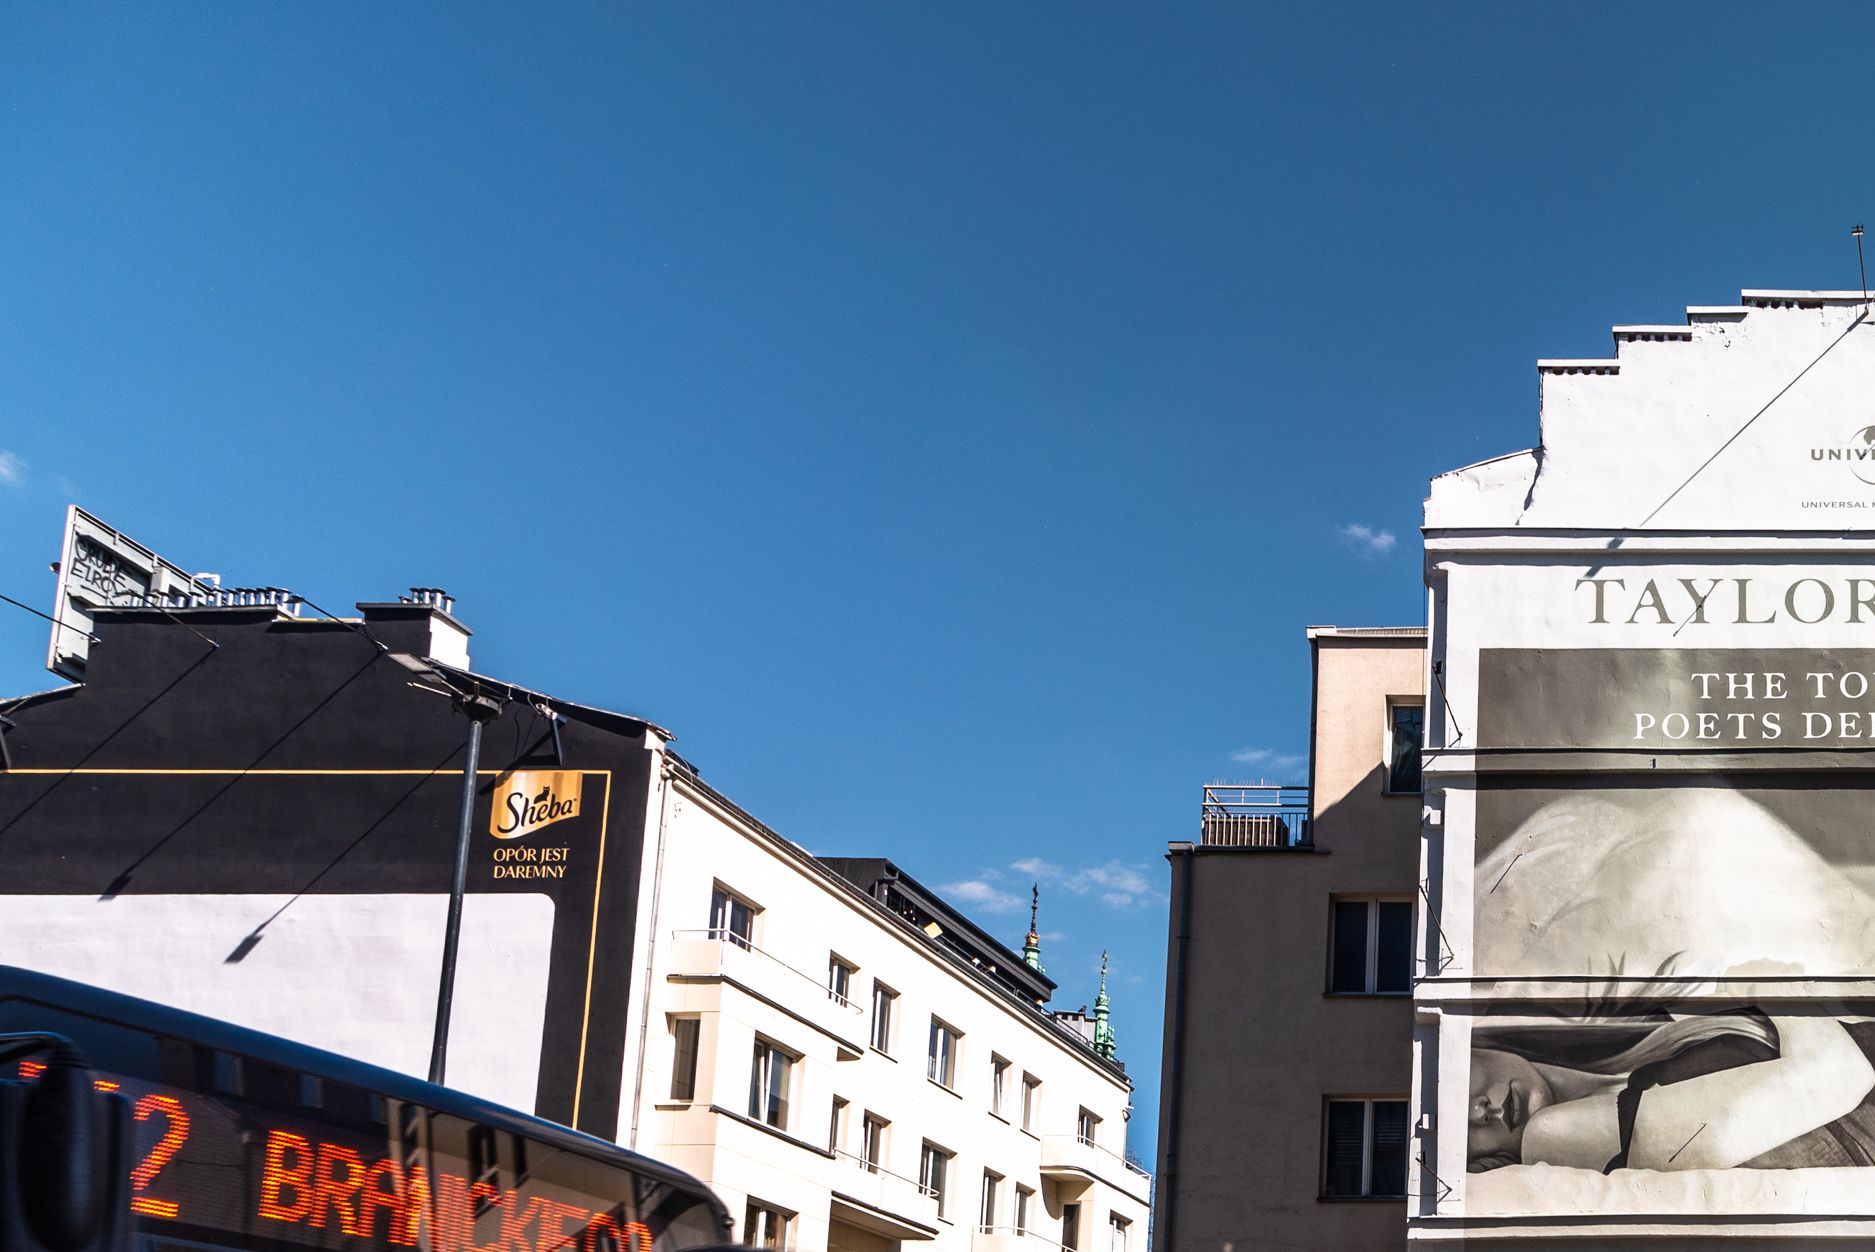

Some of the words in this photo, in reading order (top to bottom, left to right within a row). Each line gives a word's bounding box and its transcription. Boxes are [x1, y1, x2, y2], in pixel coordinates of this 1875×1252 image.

[1691, 672, 1788, 700] THE
[1633, 711, 1782, 742] POETS
[497, 791, 574, 834] Sheba
[493, 845, 537, 862] OPÓR
[540, 848, 570, 863] JEST
[493, 865, 567, 879] DAREMNY
